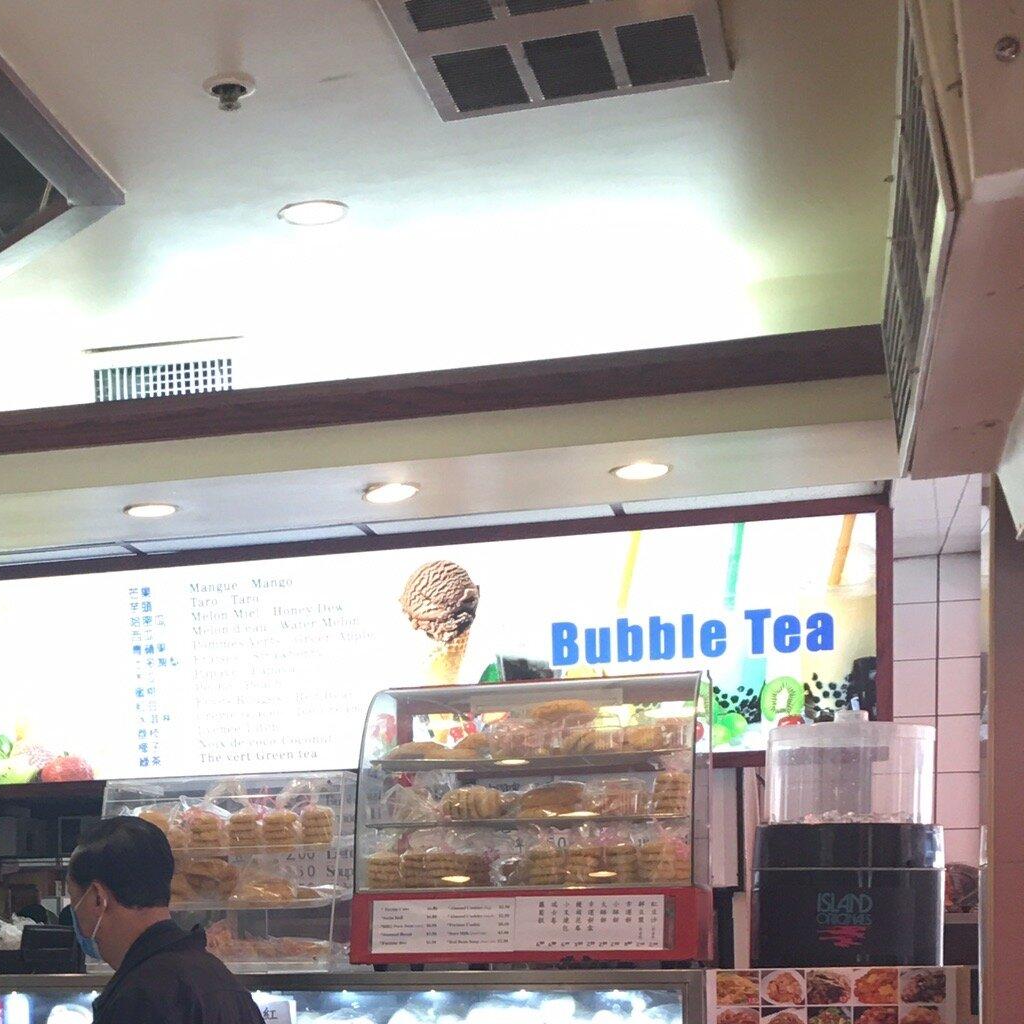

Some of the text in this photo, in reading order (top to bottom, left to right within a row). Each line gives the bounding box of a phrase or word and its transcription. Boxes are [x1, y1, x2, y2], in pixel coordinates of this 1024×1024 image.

[190, 578, 293, 594] Mangue Mango
[190, 594, 259, 607] Taro Taro
[552, 608, 834, 666] Bubble Tea
[816, 892, 874, 913] ISLAND
